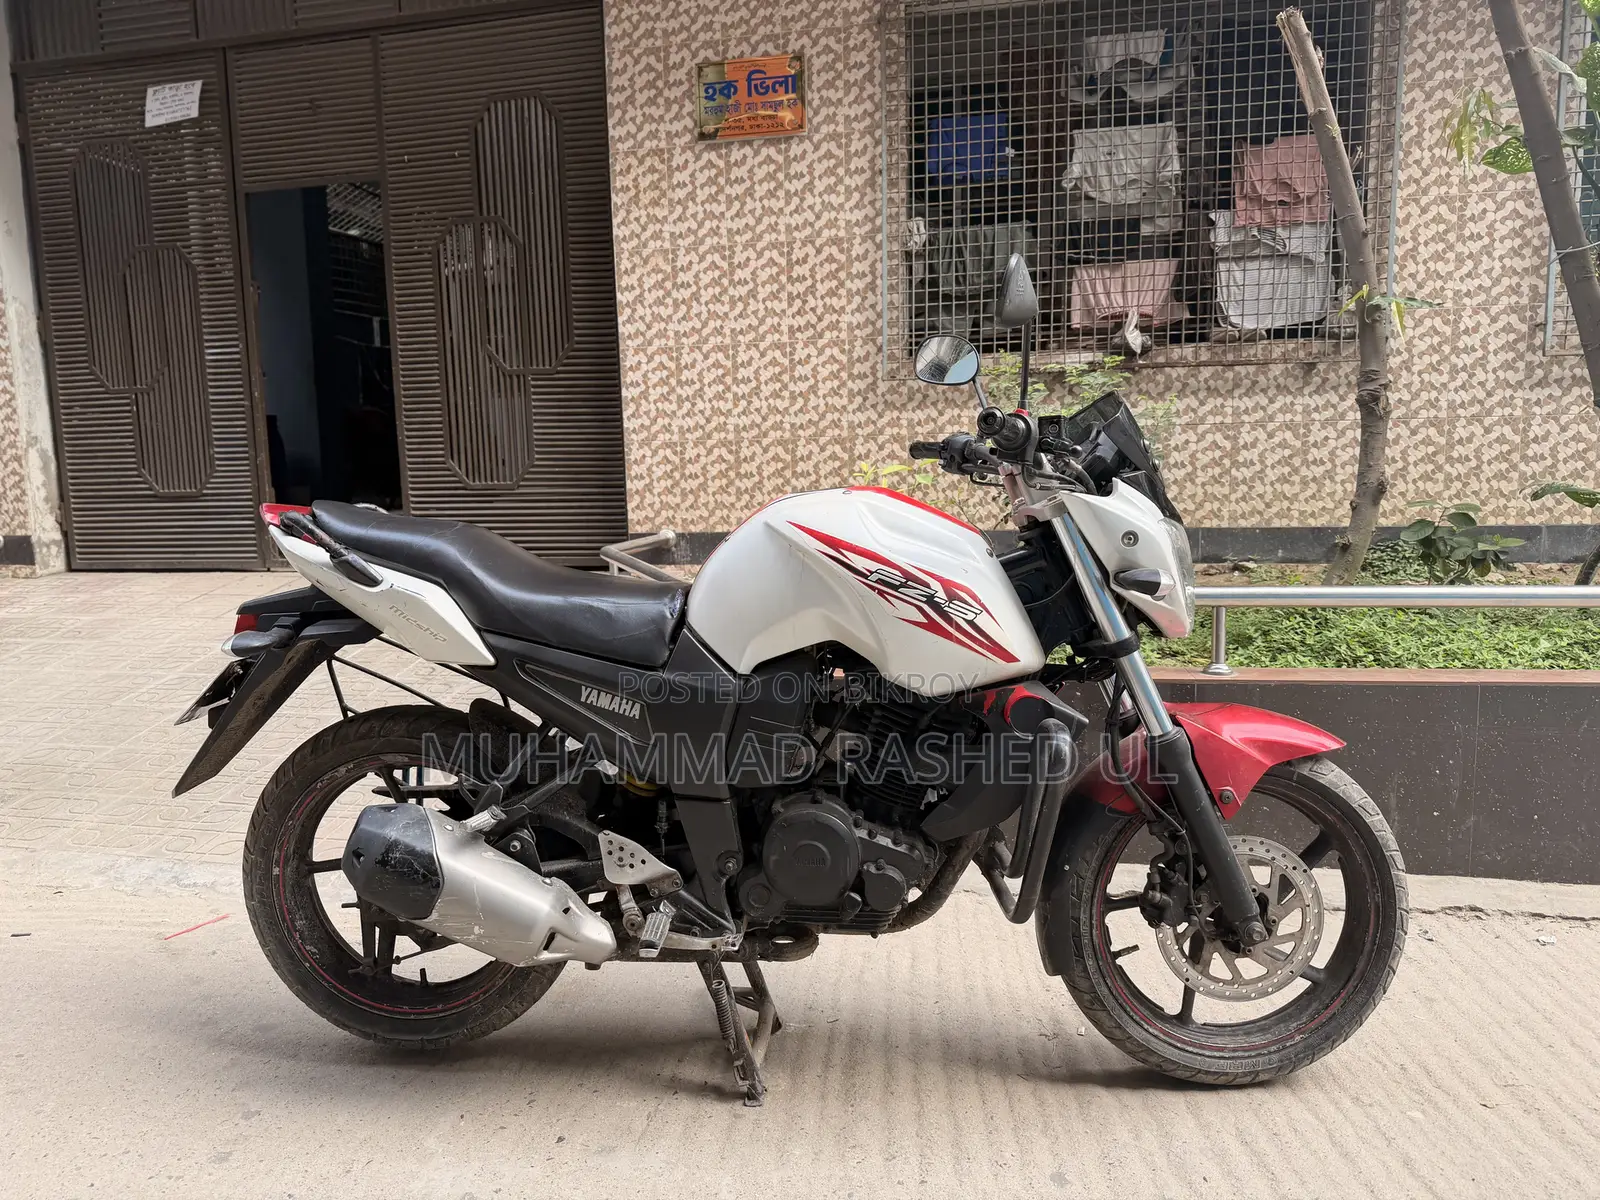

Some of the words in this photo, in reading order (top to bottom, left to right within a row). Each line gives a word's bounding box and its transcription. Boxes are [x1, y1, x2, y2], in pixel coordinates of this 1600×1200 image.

[703, 80, 738, 102] হক
[745, 69, 797, 98] ভিলা
[786, 99, 799, 109] হক
[579, 685, 641, 720] YAMAHA
